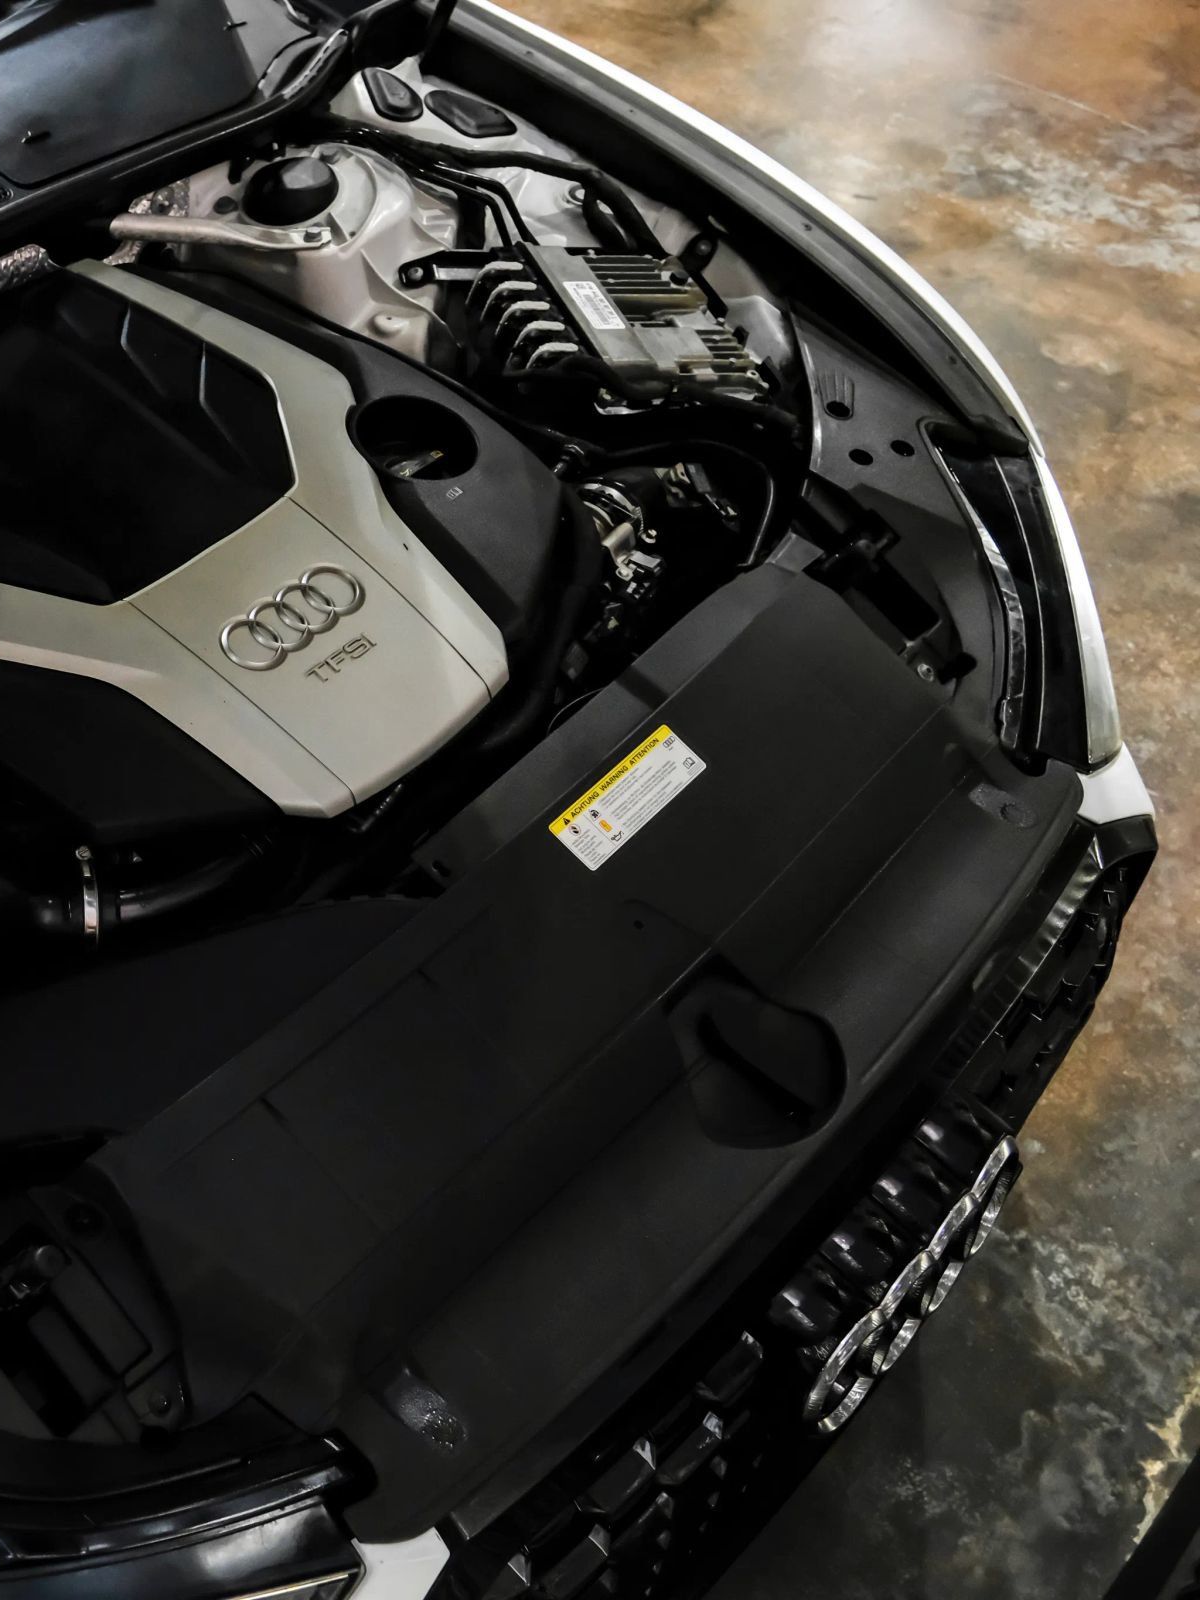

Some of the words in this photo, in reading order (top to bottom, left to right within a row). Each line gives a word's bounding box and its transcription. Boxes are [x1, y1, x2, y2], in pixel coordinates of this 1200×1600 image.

[304, 632, 377, 683] TFSI
[570, 790, 600, 818] ACHTUNG
[600, 765, 629, 792] WARNING
[629, 737, 660, 766] ATTENTION
